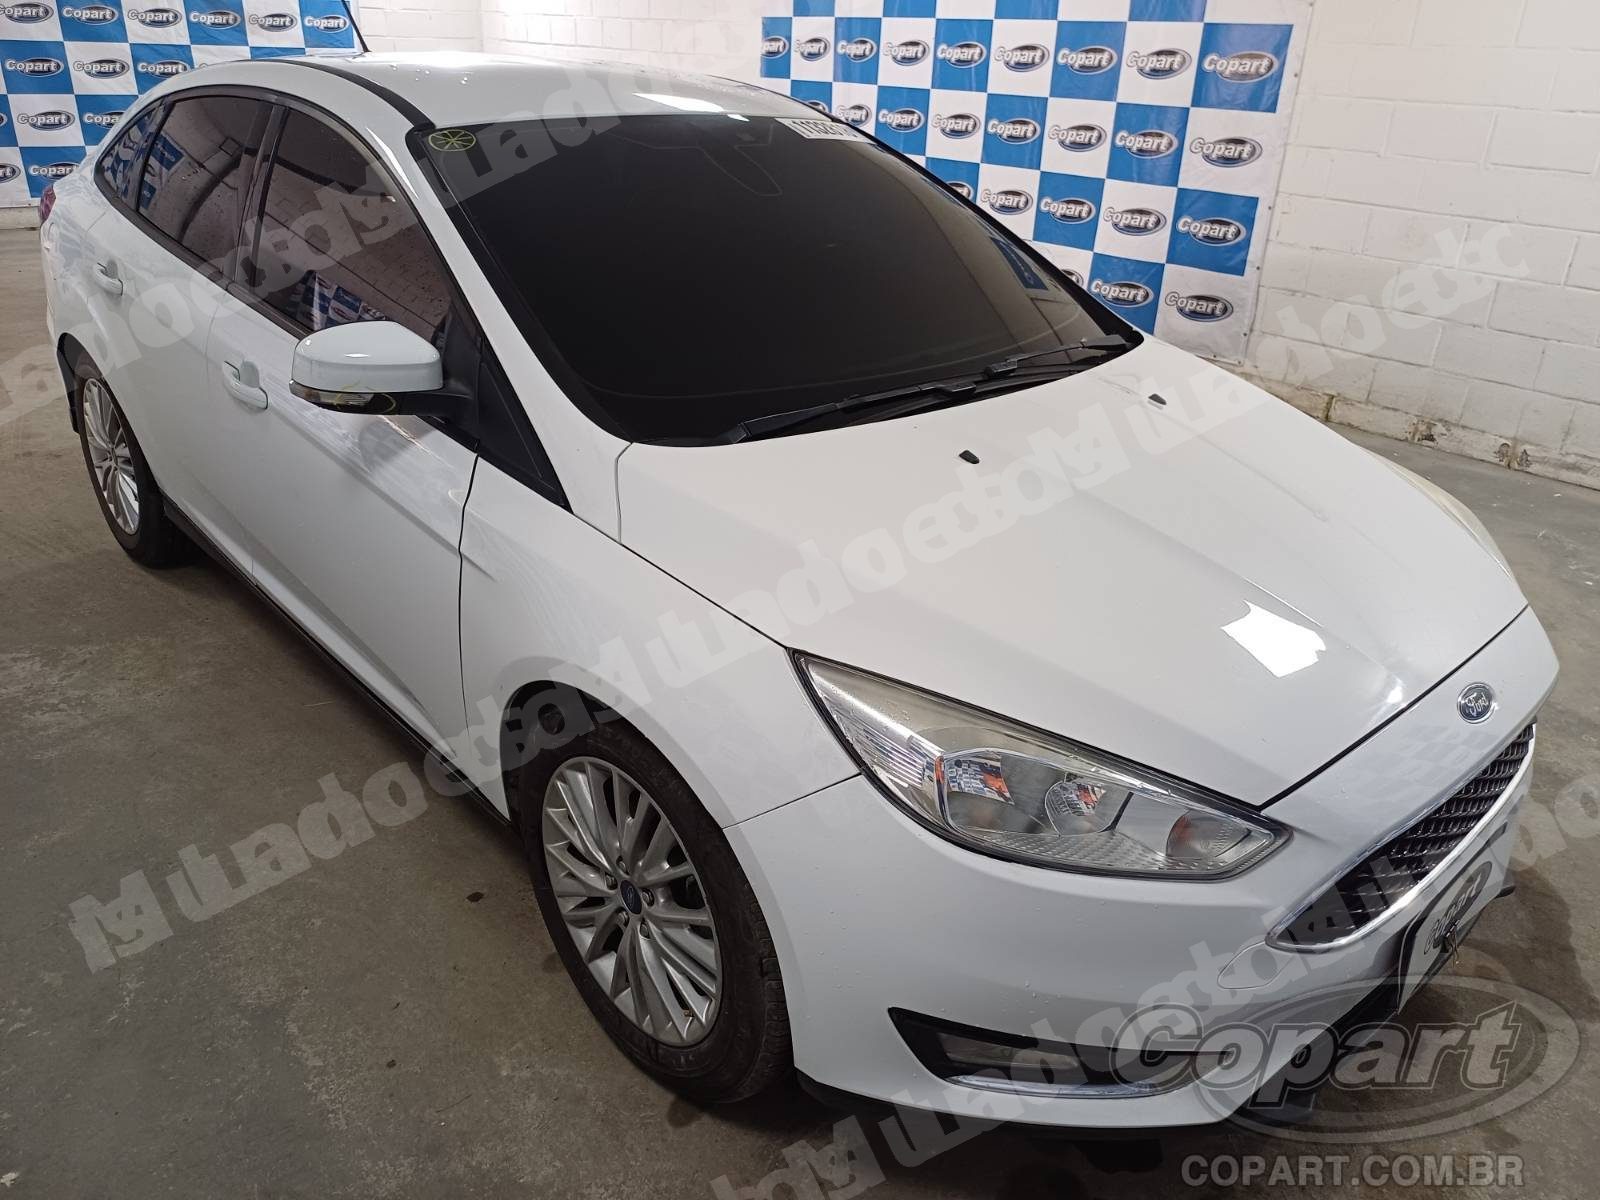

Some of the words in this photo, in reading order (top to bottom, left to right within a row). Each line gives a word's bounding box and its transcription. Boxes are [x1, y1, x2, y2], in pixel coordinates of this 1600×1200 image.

[62, 7, 113, 20] Copart
[128, 9, 176, 23] Copart
[190, 11, 236, 25] Copart
[249, 12, 292, 27] Copart
[304, 15, 345, 29] Copart
[795, 39, 827, 56] Copart
[838, 40, 873, 57] Copart
[883, 41, 925, 60] Copart
[937, 42, 981, 61] Copart
[994, 46, 1042, 64] Copart
[5, 58, 58, 74] Copart
[73, 60, 123, 75] Copart
[137, 61, 185, 74] Copart
[1057, 47, 1110, 69] Copart
[1126, 48, 1183, 71] Copart
[1202, 53, 1272, 77] Copart
[17, 112, 68, 126] Copart
[83, 112, 121, 126] Copa
[877, 108, 919, 126] Copart
[931, 114, 975, 133] Copart
[987, 119, 1034, 139] Copart
[1049, 125, 1100, 145] Copart
[1115, 131, 1173, 154] Copart
[1190, 137, 1253, 161] Copart
[981, 188, 1026, 209] Copart
[1039, 196, 1092, 219] Copart
[1103, 207, 1159, 230] Copart
[1176, 216, 1239, 241] Copart
[1090, 279, 1147, 304] Copart
[1165, 291, 1225, 317] Copart
[1462, 691, 1489, 717] Ford
